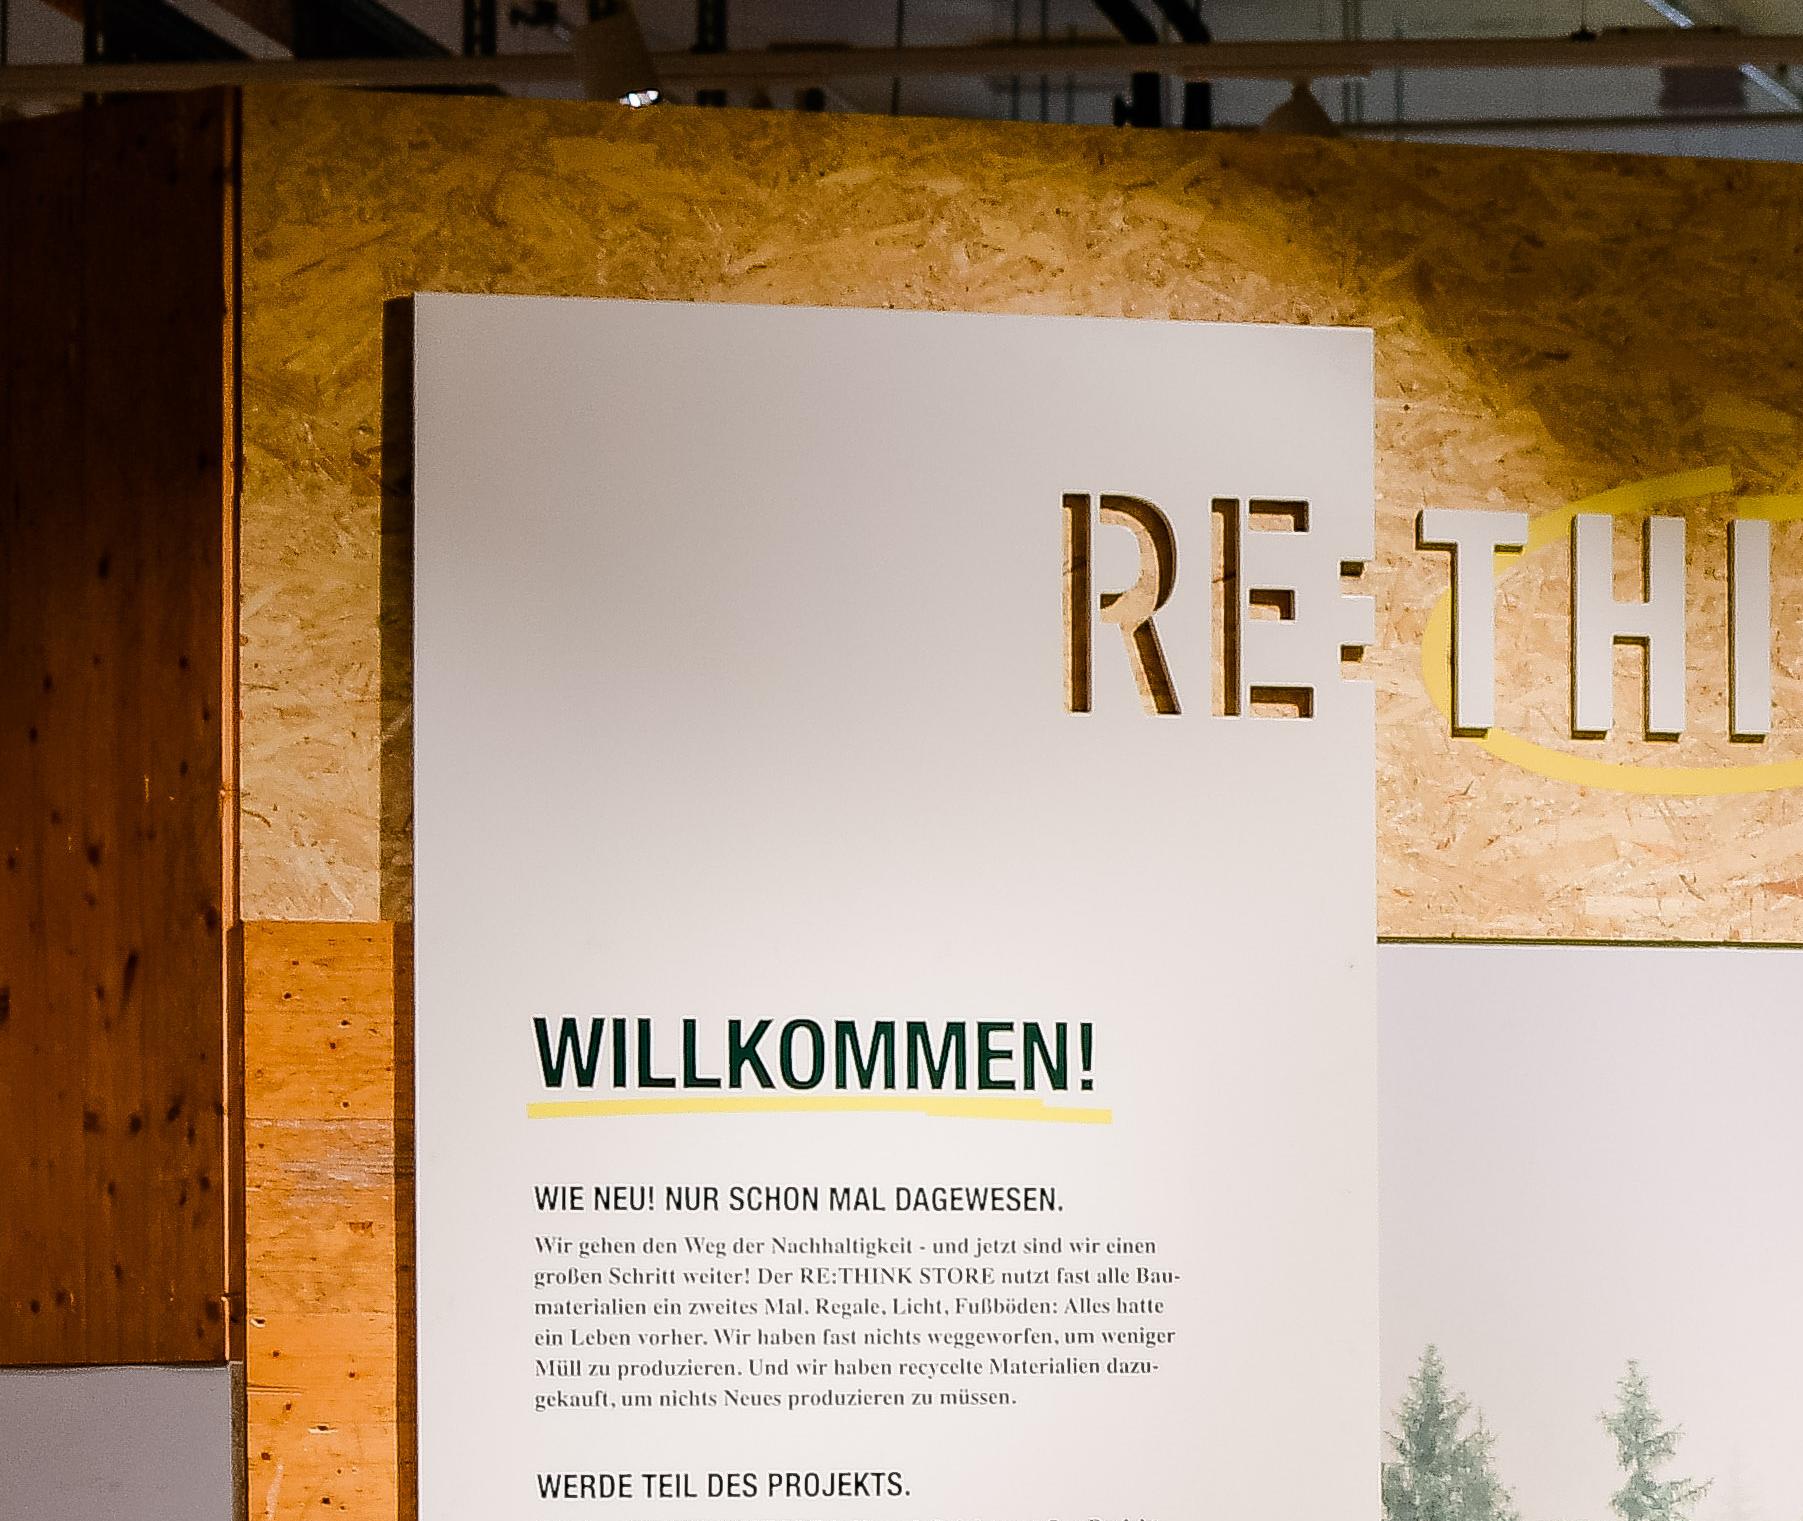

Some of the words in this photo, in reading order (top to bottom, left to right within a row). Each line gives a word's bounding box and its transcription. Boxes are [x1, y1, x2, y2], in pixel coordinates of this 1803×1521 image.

[533, 1017, 1095, 1091] WILLKOMMEN!
[533, 1185, 585, 1212] WIE
[593, 1185, 655, 1212] NEU!
[665, 1185, 719, 1212] NUR
[728, 1185, 819, 1212] SCHON
[829, 1186, 887, 1212] MAL
[895, 1186, 1064, 1212] DAGEWESEN.
[534, 1236, 574, 1255] Wir
[578, 1236, 636, 1259] gehen
[642, 1237, 677, 1255] den
[684, 1236, 727, 1259] Weg
[732, 1236, 766, 1255] der
[771, 1236, 913, 1259] Nachhaltigkeit
[932, 1237, 969, 1254] und
[973, 1237, 1017, 1259] jetzt
[1022, 1236, 1062, 1255] sind
[1068, 1236, 1101, 1254] wir
[1106, 1236, 1156, 1255] einen
[533, 1266, 603, 1290] großen
[608, 1266, 676, 1286] Schritt
[682, 1267, 750, 1285] weiter!
[758, 1267, 794, 1285] Der
[800, 1266, 913, 1285] RE:THINK
[919, 1267, 996, 1285] STORE
[1001, 1268, 1050, 1285] nutzt
[1057, 1267, 1090, 1285] fast
[1096, 1266, 1130, 1284] alle
[1135, 1266, 1181, 1284] Bau-
[534, 1297, 647, 1316] materialien
[653, 1297, 682, 1316] ein
[687, 1298, 758, 1316] zweites
[764, 1297, 809, 1316] Mal.
[815, 1297, 887, 1320] Regale,
[892, 1297, 949, 1316] Licht,
[955, 1297, 1058, 1315] Fußböden:
[1063, 1297, 1111, 1315] Alles
[1116, 1296, 1164, 1314] hatte
[534, 1328, 564, 1347] ein
[570, 1328, 631, 1346] Leben
[637, 1328, 708, 1346] vorher.
[713, 1328, 752, 1346] Wir
[757, 1327, 816, 1346] haben
[823, 1328, 857, 1346] fast
[864, 1327, 921, 1346] nichts
[927, 1327, 1060, 1349] weggeworfen,
[1064, 1331, 1095, 1345] um
[1101, 1326, 1177, 1349] weniger
[535, 1359, 582, 1377] Müll
[587, 1363, 611, 1377] zu
[617, 1358, 743, 1382] produzieren.
[748, 1358, 789, 1377] Und
[796, 1358, 828, 1376] wir
[833, 1358, 892, 1376] haben
[899, 1357, 983, 1380] recycelte
[989, 1357, 1100, 1375] Materialien
[1106, 1356, 1159, 1375] dazu-
[534, 1389, 616, 1413] gekauft,
[621, 1394, 653, 1407] um
[659, 1389, 718, 1407] nichts
[723, 1389, 782, 1407] Neues
[788, 1388, 905, 1411] produzieren
[911, 1393, 933, 1406] zu
[939, 1388, 1017, 1406] müssen.
[536, 1473, 633, 1500] WERDE
[640, 1473, 699, 1499] TEIL
[707, 1472, 758, 1498] DES
[768, 1471, 911, 1498] PROJEKTS.
